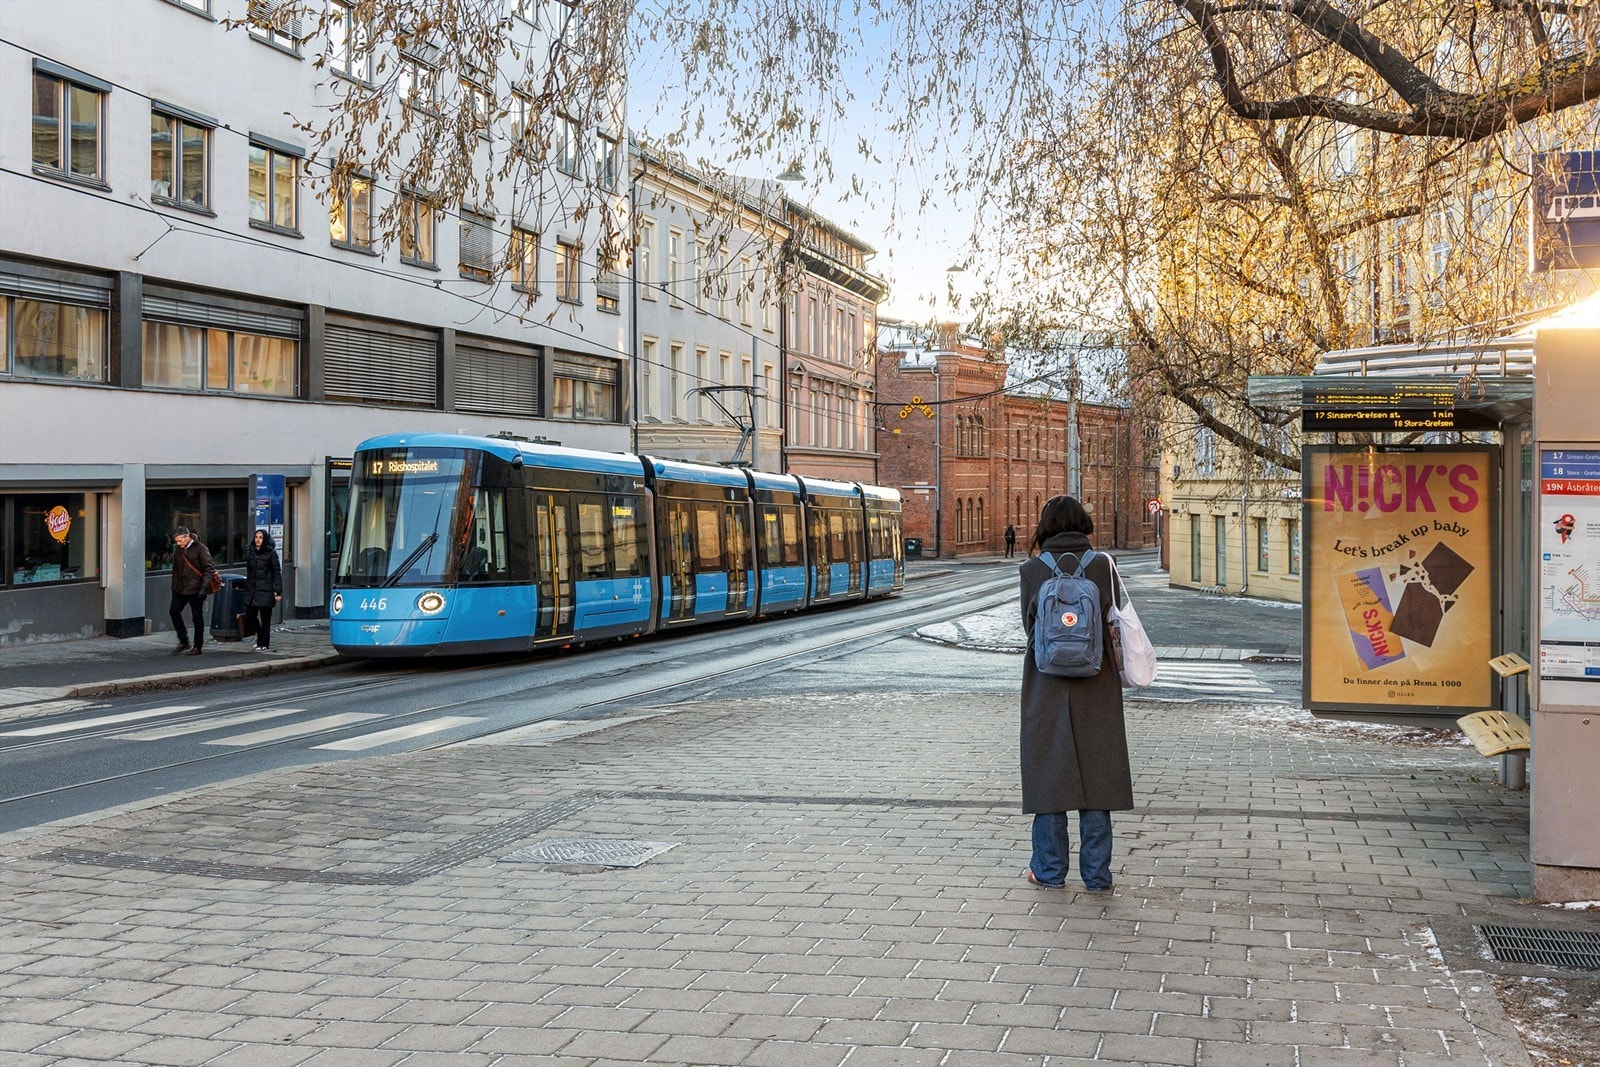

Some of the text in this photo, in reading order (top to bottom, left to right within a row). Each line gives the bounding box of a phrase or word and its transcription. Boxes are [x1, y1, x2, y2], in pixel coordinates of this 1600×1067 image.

[373, 461, 437, 473] 17 Rikshospitalet
[1333, 520, 1469, 558] Let's break up baby
[360, 597, 387, 610] 446
[1401, 678, 1411, 686] på
